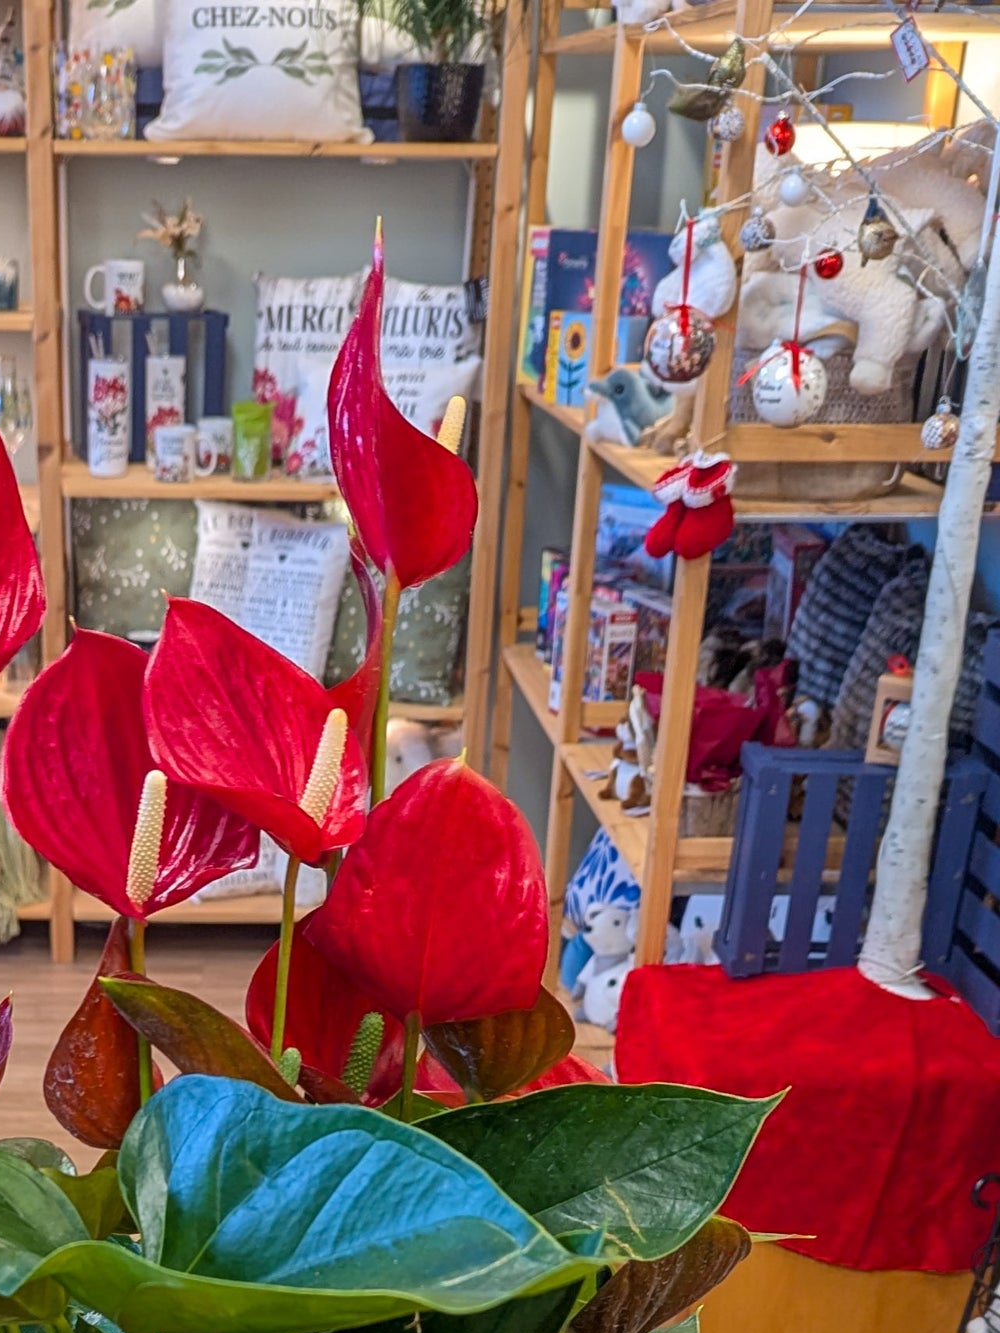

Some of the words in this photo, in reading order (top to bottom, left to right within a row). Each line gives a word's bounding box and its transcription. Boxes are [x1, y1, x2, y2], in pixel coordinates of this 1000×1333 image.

[192, 6, 337, 30] CHEZ-NOUS
[266, 304, 344, 334] MERCI
[383, 305, 464, 340] FLEURIS
